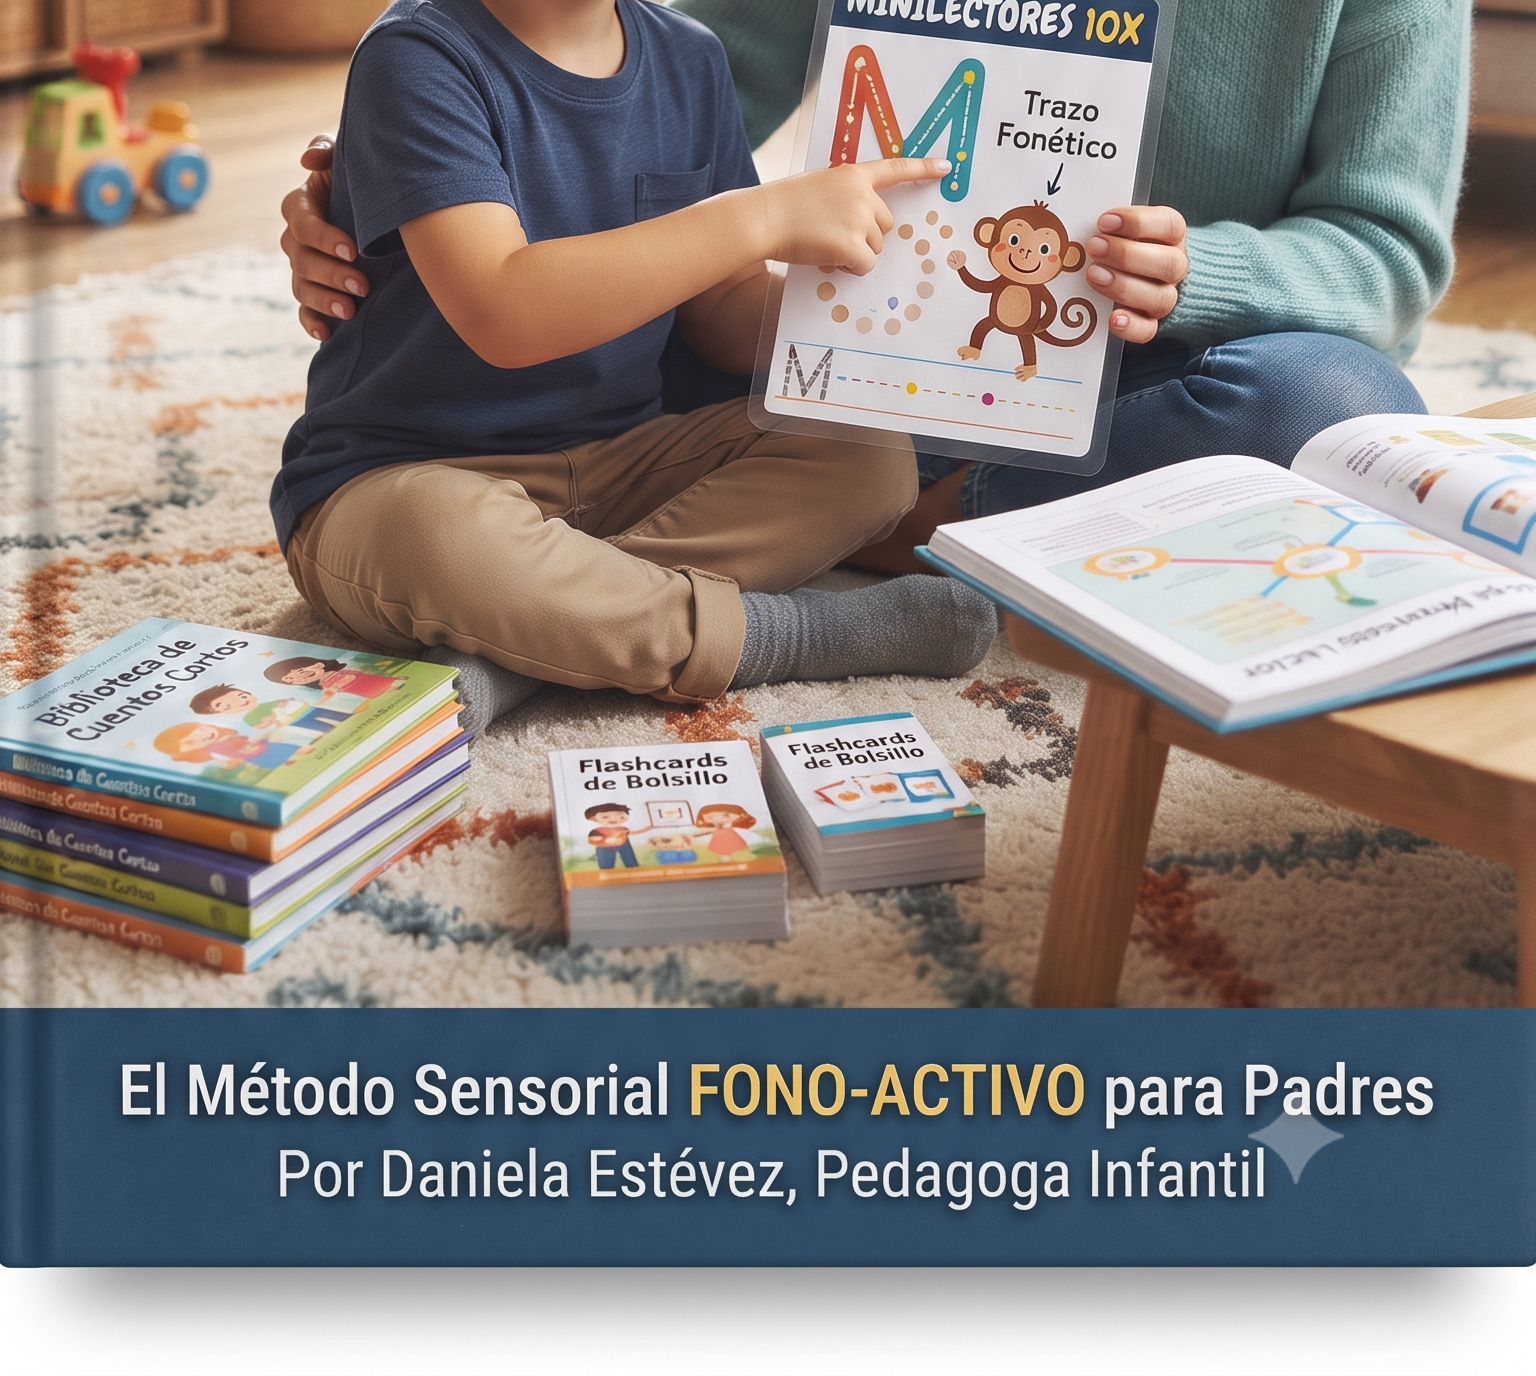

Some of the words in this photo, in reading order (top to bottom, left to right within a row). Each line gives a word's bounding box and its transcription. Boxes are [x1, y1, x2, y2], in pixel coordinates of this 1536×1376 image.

[1084, 7, 1145, 46] 10X
[1023, 89, 1100, 122] Trazo
[996, 122, 1117, 160] Fonético
[33, 658, 166, 727] Biblioteca
[157, 639, 197, 659] de
[66, 683, 177, 741] Cuentos
[164, 639, 249, 682] Cortos
[579, 752, 728, 774] Flashcards
[788, 732, 917, 756] Flashcards
[804, 756, 833, 770] de
[835, 747, 925, 766] Bolsillo
[584, 776, 617, 791] de
[626, 771, 728, 789] Bolsillo
[123, 1061, 166, 1115] El
[189, 1061, 394, 1116] Método
[414, 1061, 668, 1116] Sensorial
[691, 1063, 1085, 1116] FONO-ACTIVO
[1106, 1076, 1224, 1129] para
[1245, 1061, 1434, 1116] Padres
[279, 1149, 364, 1198] Por
[383, 1148, 569, 1198] Daniela
[590, 1147, 796, 1206] Estévez,
[818, 1147, 1070, 1211] Pedagoga
[1091, 1147, 1265, 1198] Infantil
